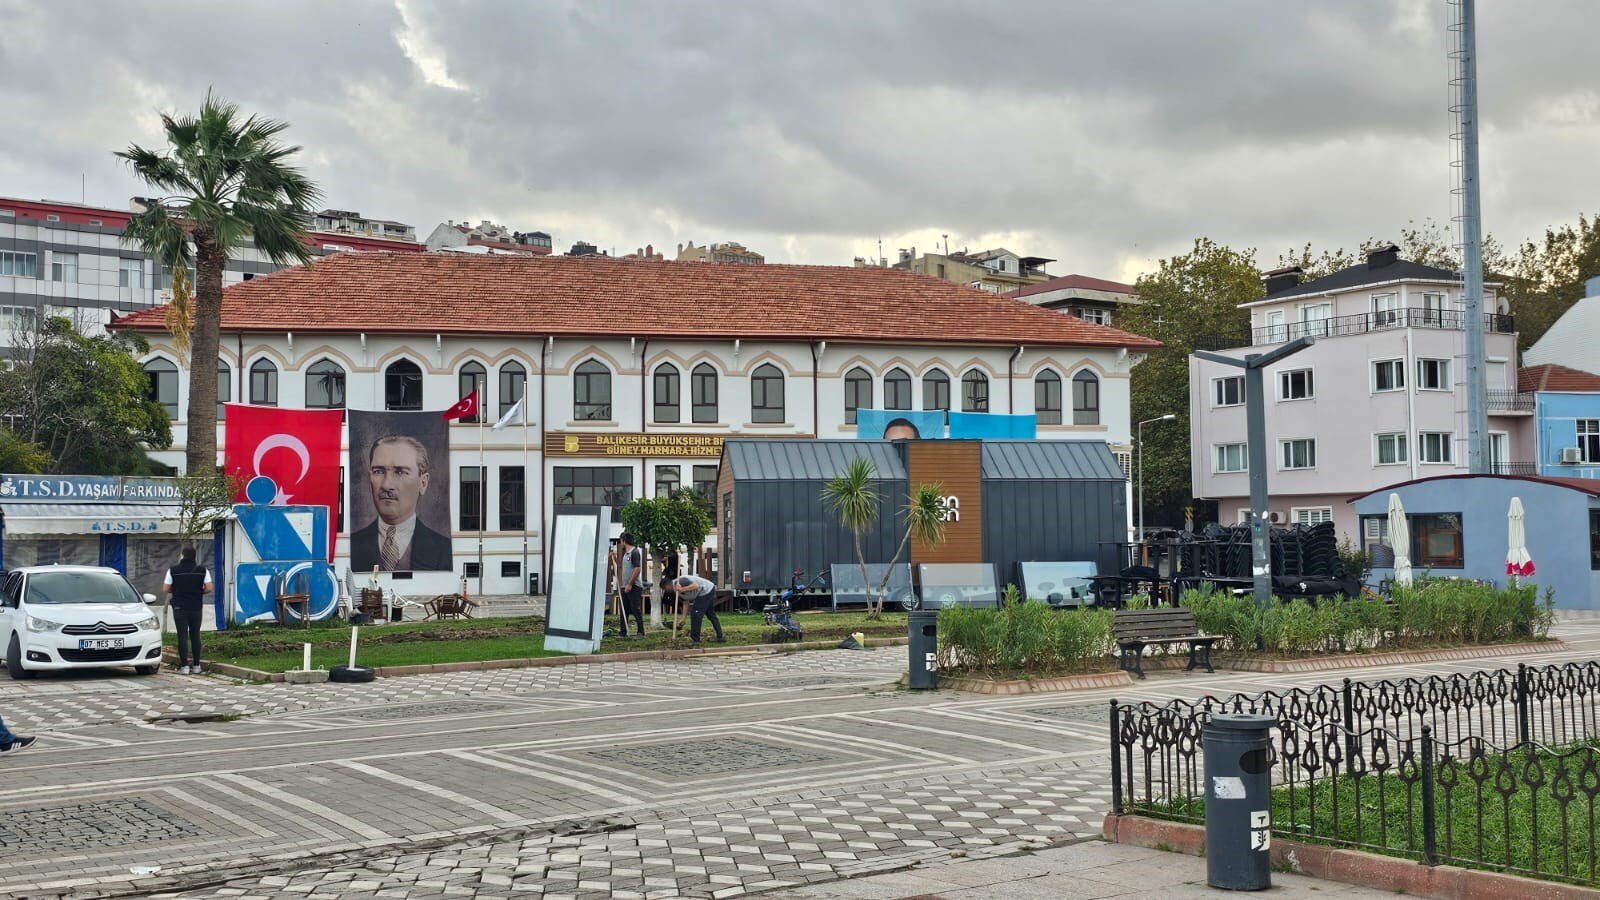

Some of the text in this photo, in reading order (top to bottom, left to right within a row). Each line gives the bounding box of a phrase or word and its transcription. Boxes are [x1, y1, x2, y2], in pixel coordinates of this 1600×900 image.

[596, 435, 648, 445] BALIKESİR
[650, 434, 711, 447] BÜYÜKŞEHİR
[606, 444, 723, 456] GÜNEY MARMARA HİZME
[78, 482, 120, 500] YAŞAM
[103, 521, 145, 532] T.S.D.
